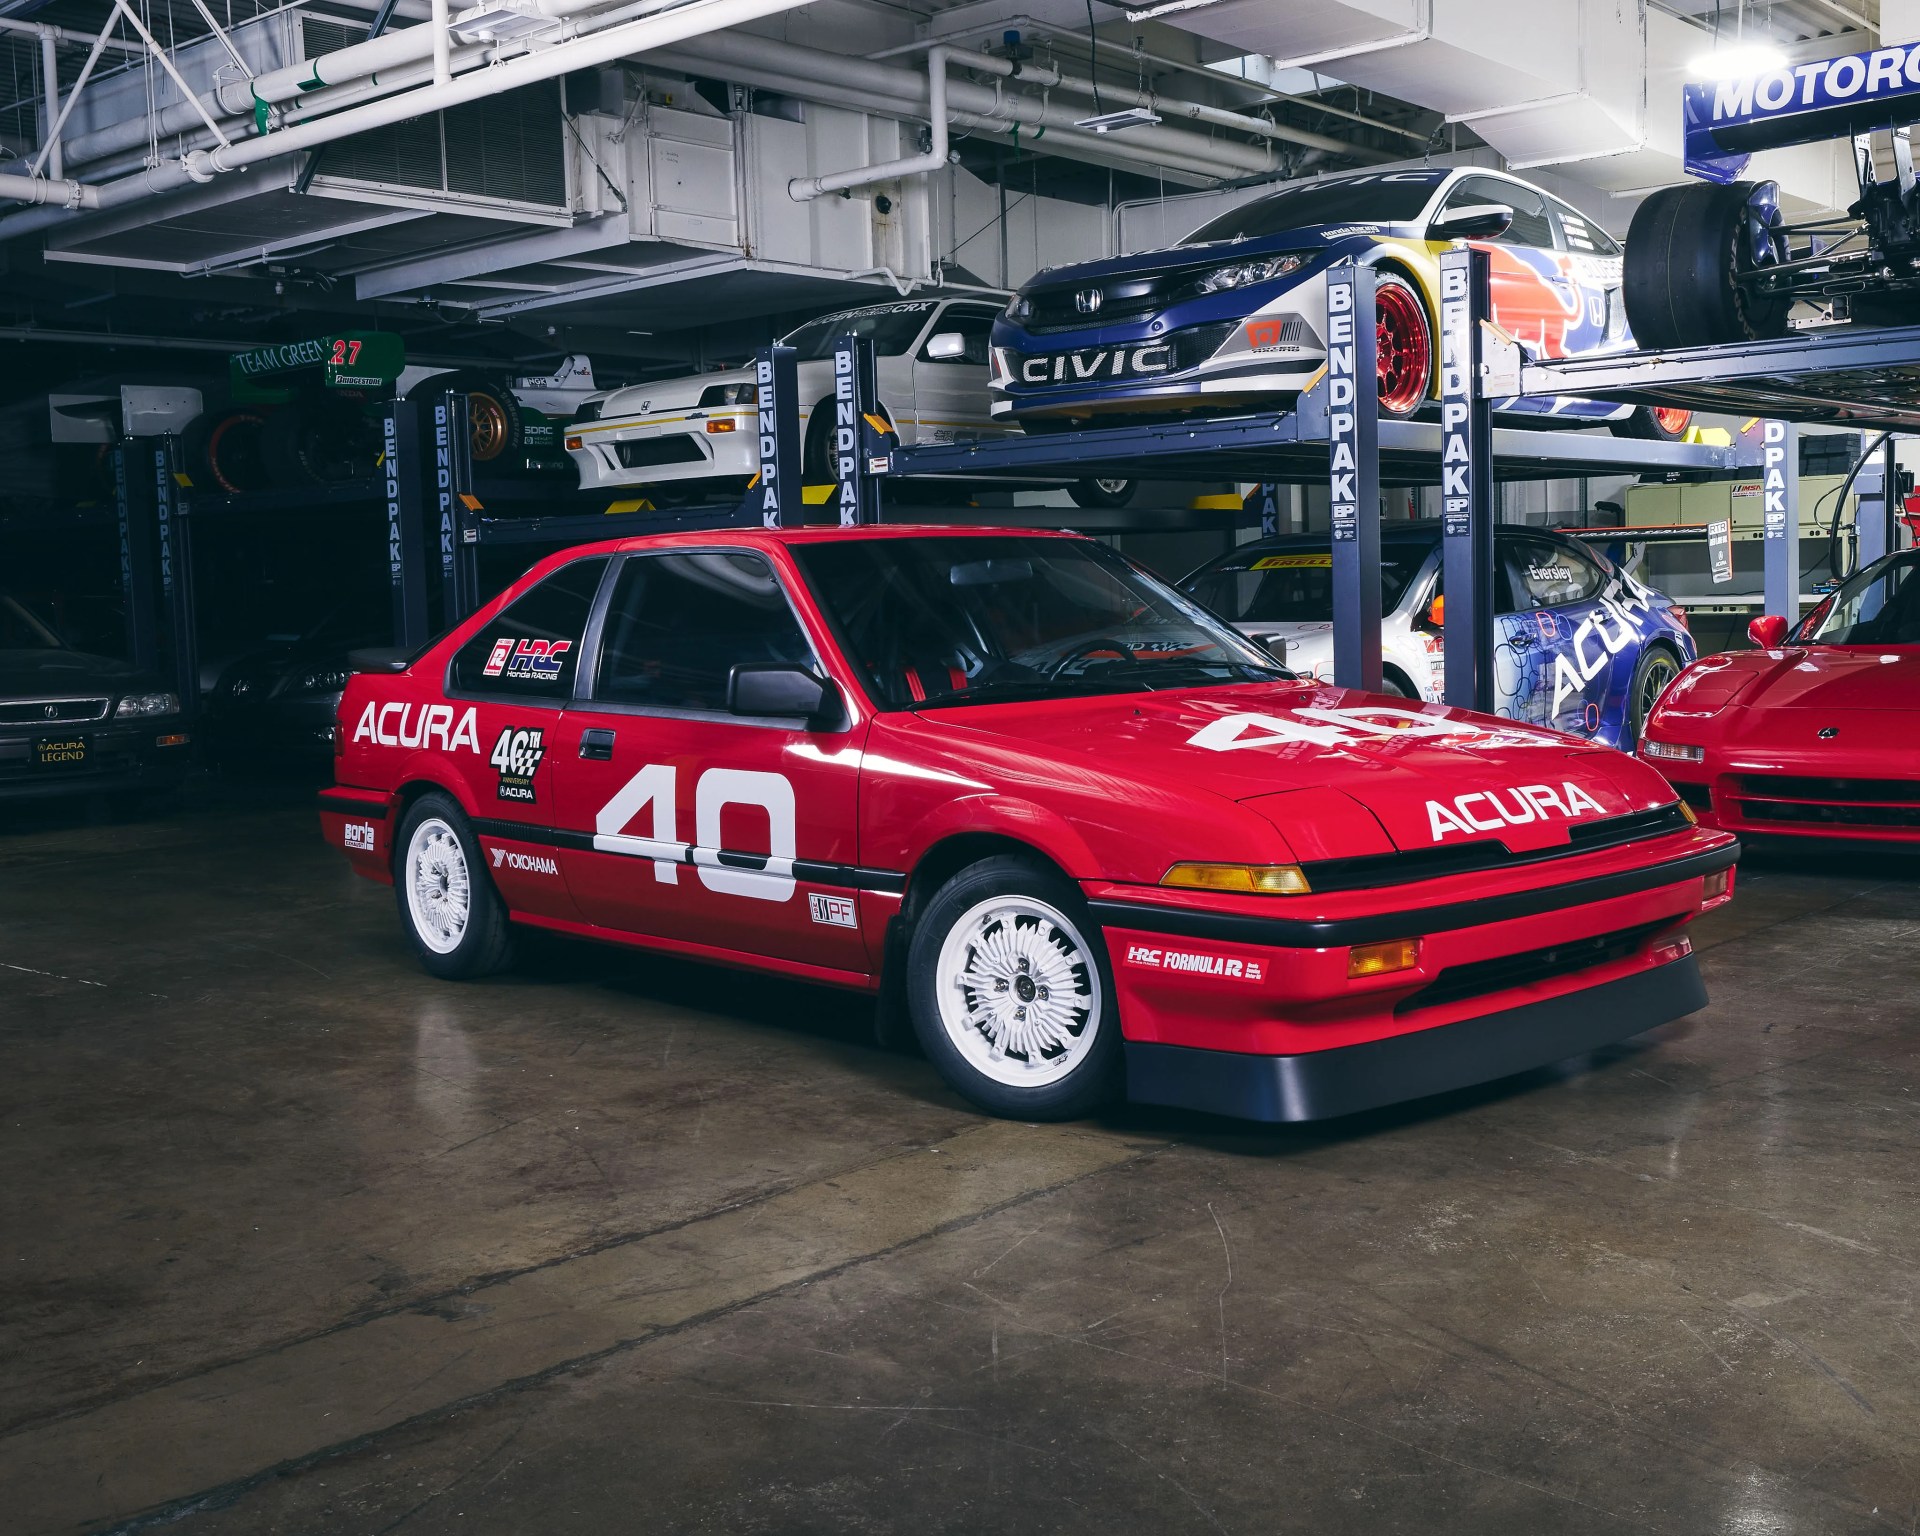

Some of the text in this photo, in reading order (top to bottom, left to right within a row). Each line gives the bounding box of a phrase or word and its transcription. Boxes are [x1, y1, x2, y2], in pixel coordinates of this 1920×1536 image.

[892, 303, 932, 313] CRX
[236, 339, 324, 374] TEAM GREEN
[331, 339, 361, 365] 27
[1023, 346, 1170, 382] CIVIC
[336, 375, 382, 386] BRIDGESTONE
[528, 377, 547, 385] NGK
[1328, 284, 1355, 501] BENDPAK
[524, 426, 553, 434] SDRC
[835, 350, 857, 526] BENDPAK
[757, 361, 778, 527] BENDPAK
[384, 417, 401, 561] BENDPAK
[435, 406, 453, 552] BENDPAK
[1710, 523, 1726, 533] RTR
[1261, 557, 1332, 568] PIRELL
[1528, 564, 1574, 584] Eversley
[508, 639, 572, 672] HRC
[1552, 566, 1654, 720] ACURA
[507, 671, 531, 679] Honda
[531, 672, 558, 681] RACING
[353, 701, 481, 754] ACURA
[1186, 707, 1480, 752] 40
[41, 751, 84, 762] LEGEND
[46, 742, 85, 751] ACURA
[502, 776, 529, 786] ANNIVERSARY
[505, 787, 533, 800] ACURA
[1425, 782, 1607, 842] ACURA
[593, 764, 796, 902] 40
[506, 853, 558, 875] YOKOHAMA
[829, 901, 851, 922] PF
[1127, 946, 1162, 963] HRC
[1163, 951, 1223, 975] FORMULA
